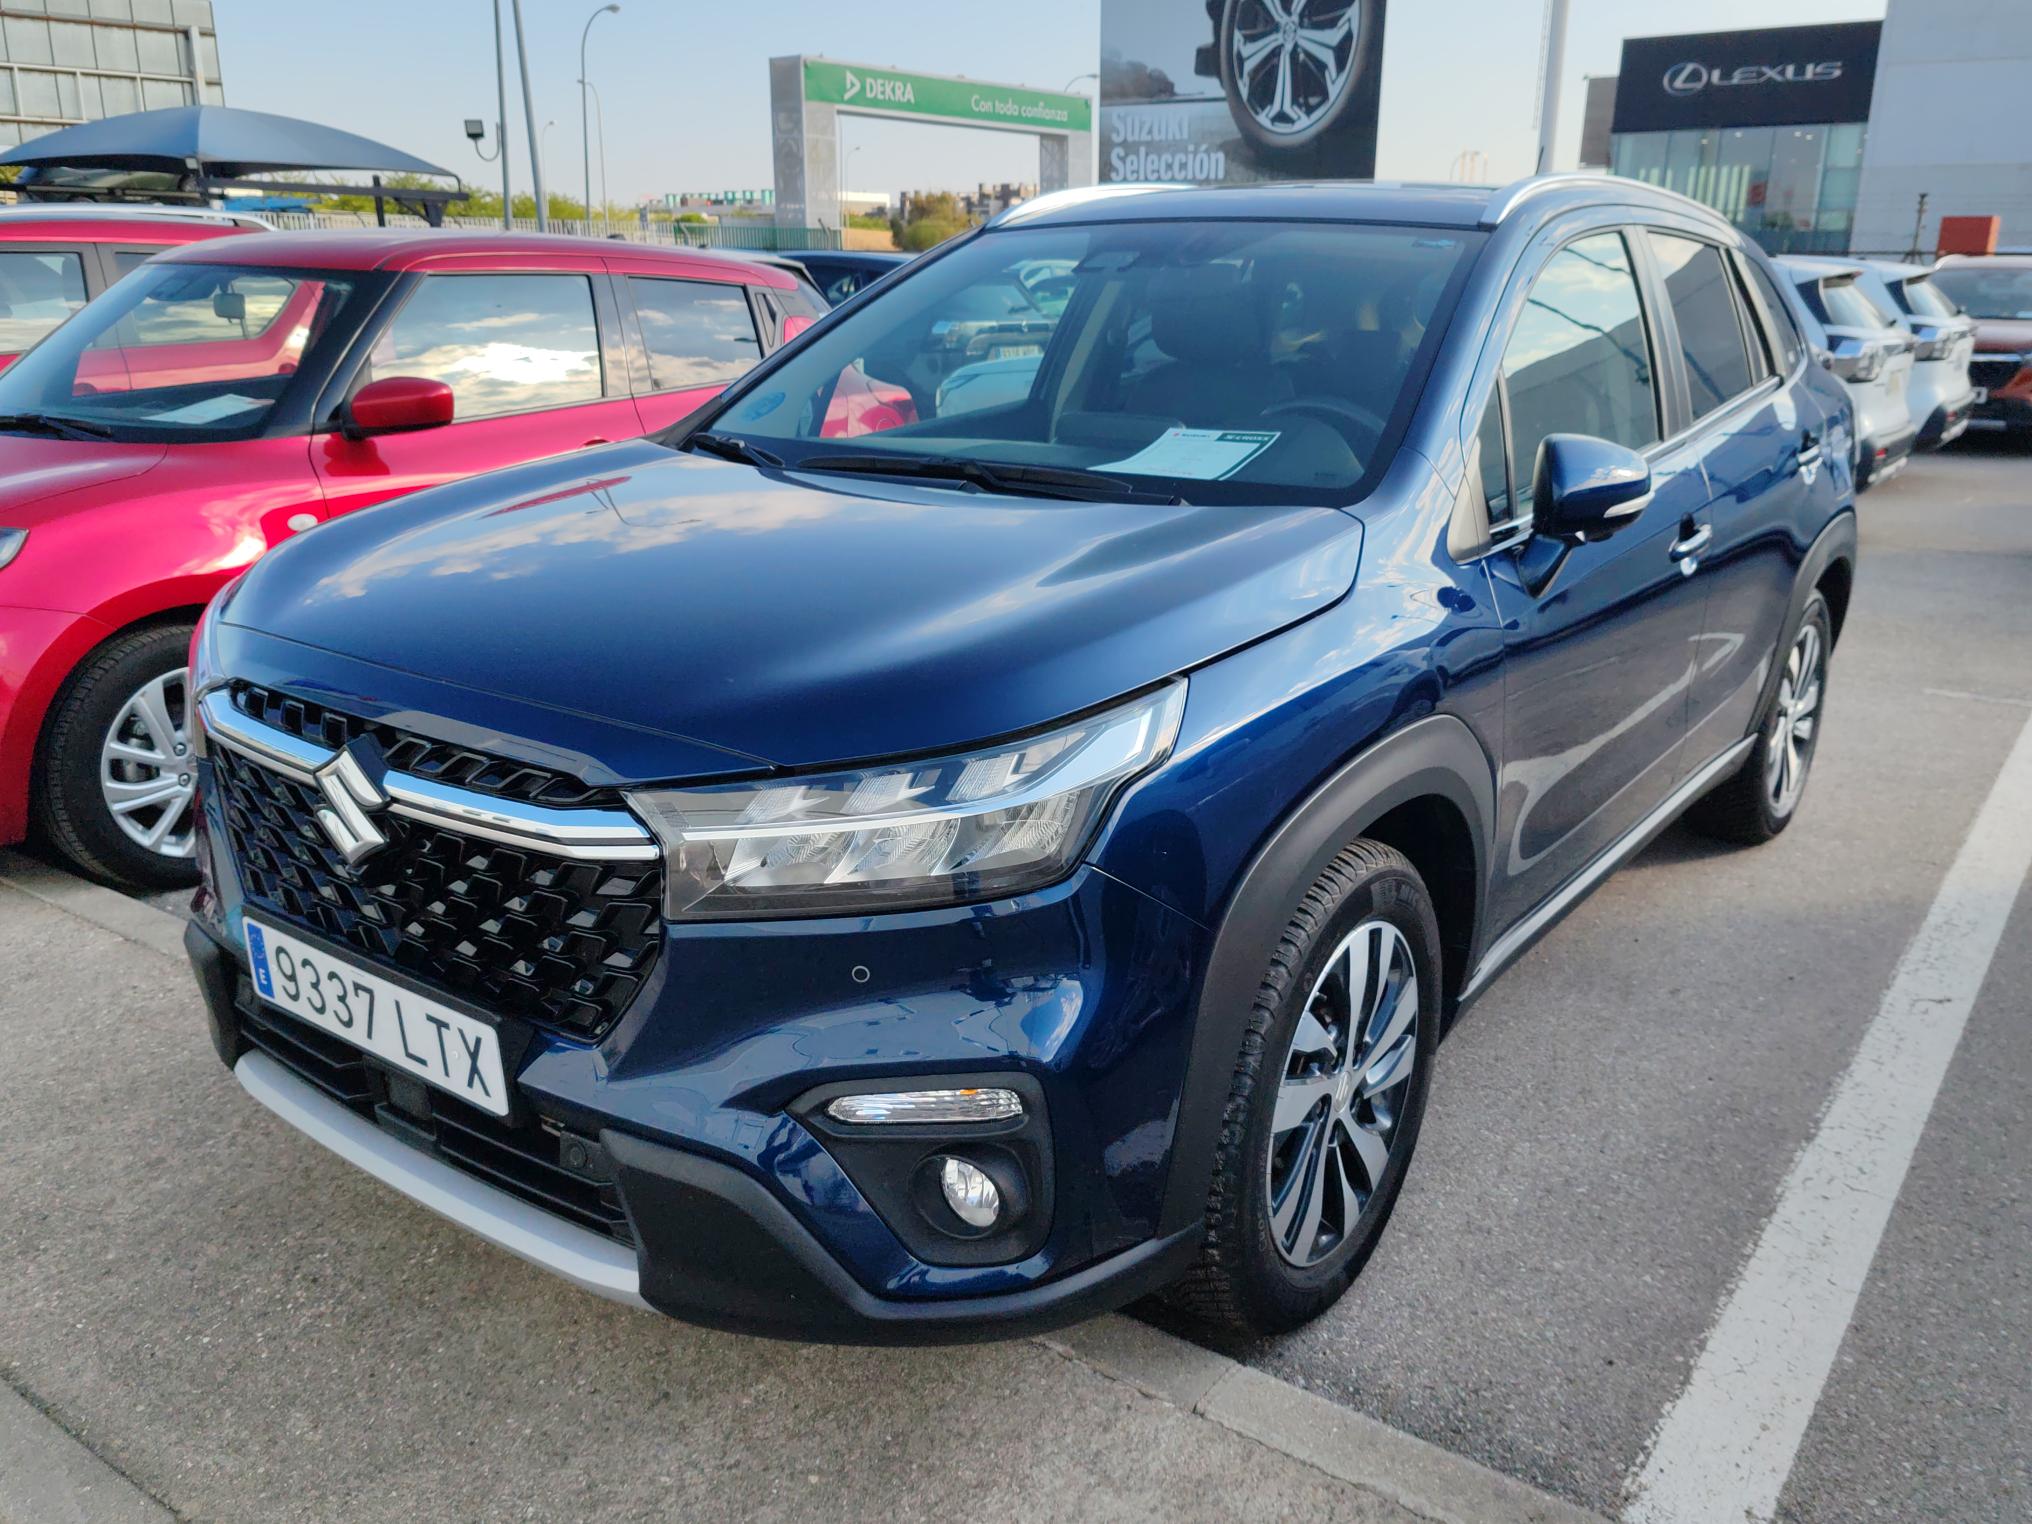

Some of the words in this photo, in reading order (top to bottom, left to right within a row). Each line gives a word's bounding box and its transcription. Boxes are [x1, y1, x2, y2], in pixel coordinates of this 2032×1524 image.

[1711, 61, 1843, 86] LEXUS
[866, 77, 915, 104] DEKRA
[970, 95, 993, 113] Con
[995, 98, 1019, 116] toda
[1021, 101, 1068, 122] confianza
[1110, 110, 1190, 143] Suzuki
[1110, 144, 1226, 181] Selección
[258, 967, 267, 985] E
[275, 946, 375, 1040] 9337
[395, 1000, 491, 1098] LTX
